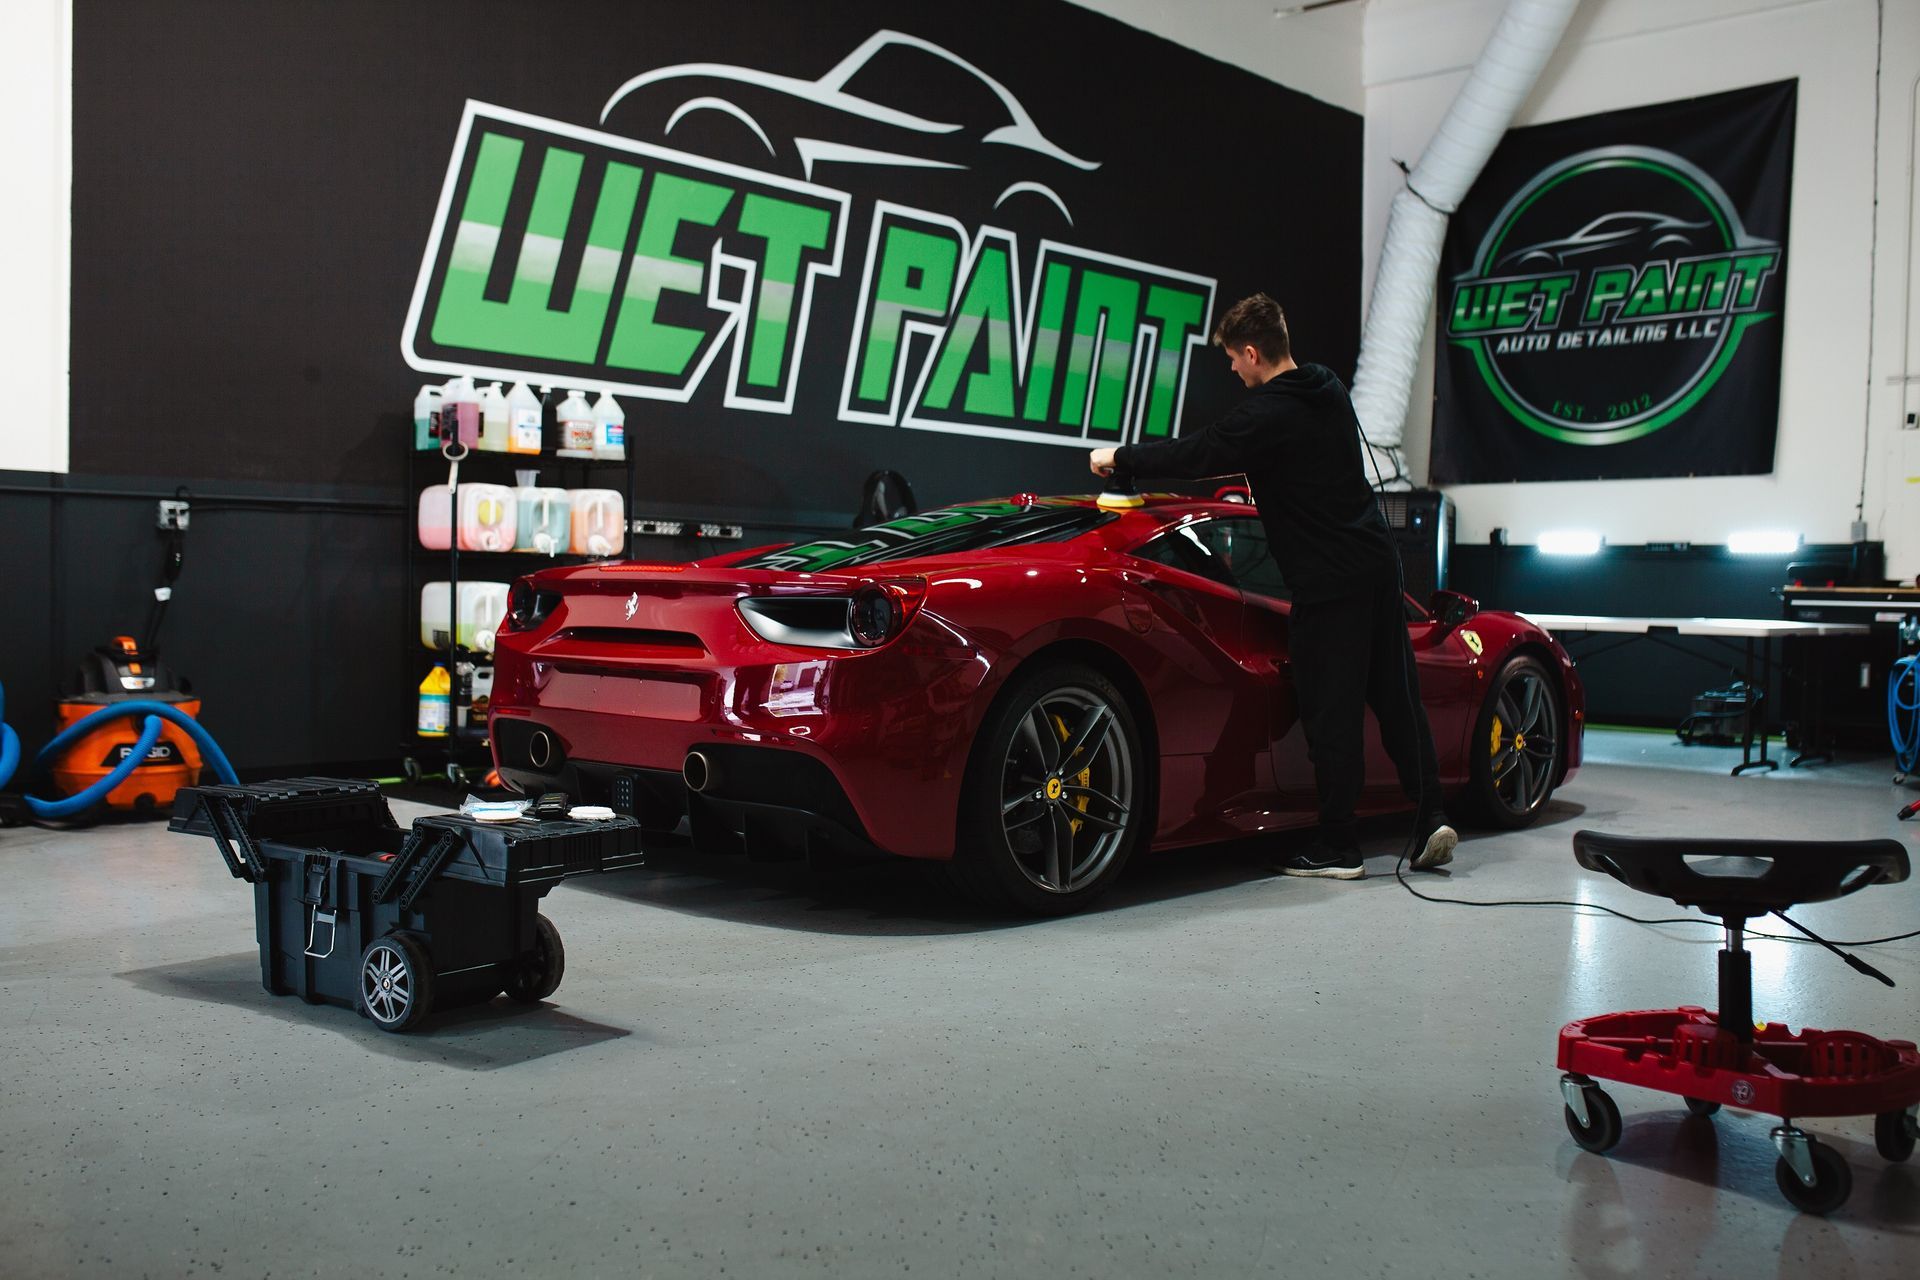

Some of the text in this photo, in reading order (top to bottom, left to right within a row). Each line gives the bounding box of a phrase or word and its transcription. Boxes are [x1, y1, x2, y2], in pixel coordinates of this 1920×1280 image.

[430, 131, 1206, 437] WET PAINT
[1451, 254, 1776, 332] WET PAINT
[1496, 317, 1722, 354] AUTO DETAILING LLC
[119, 746, 171, 759] RGID
